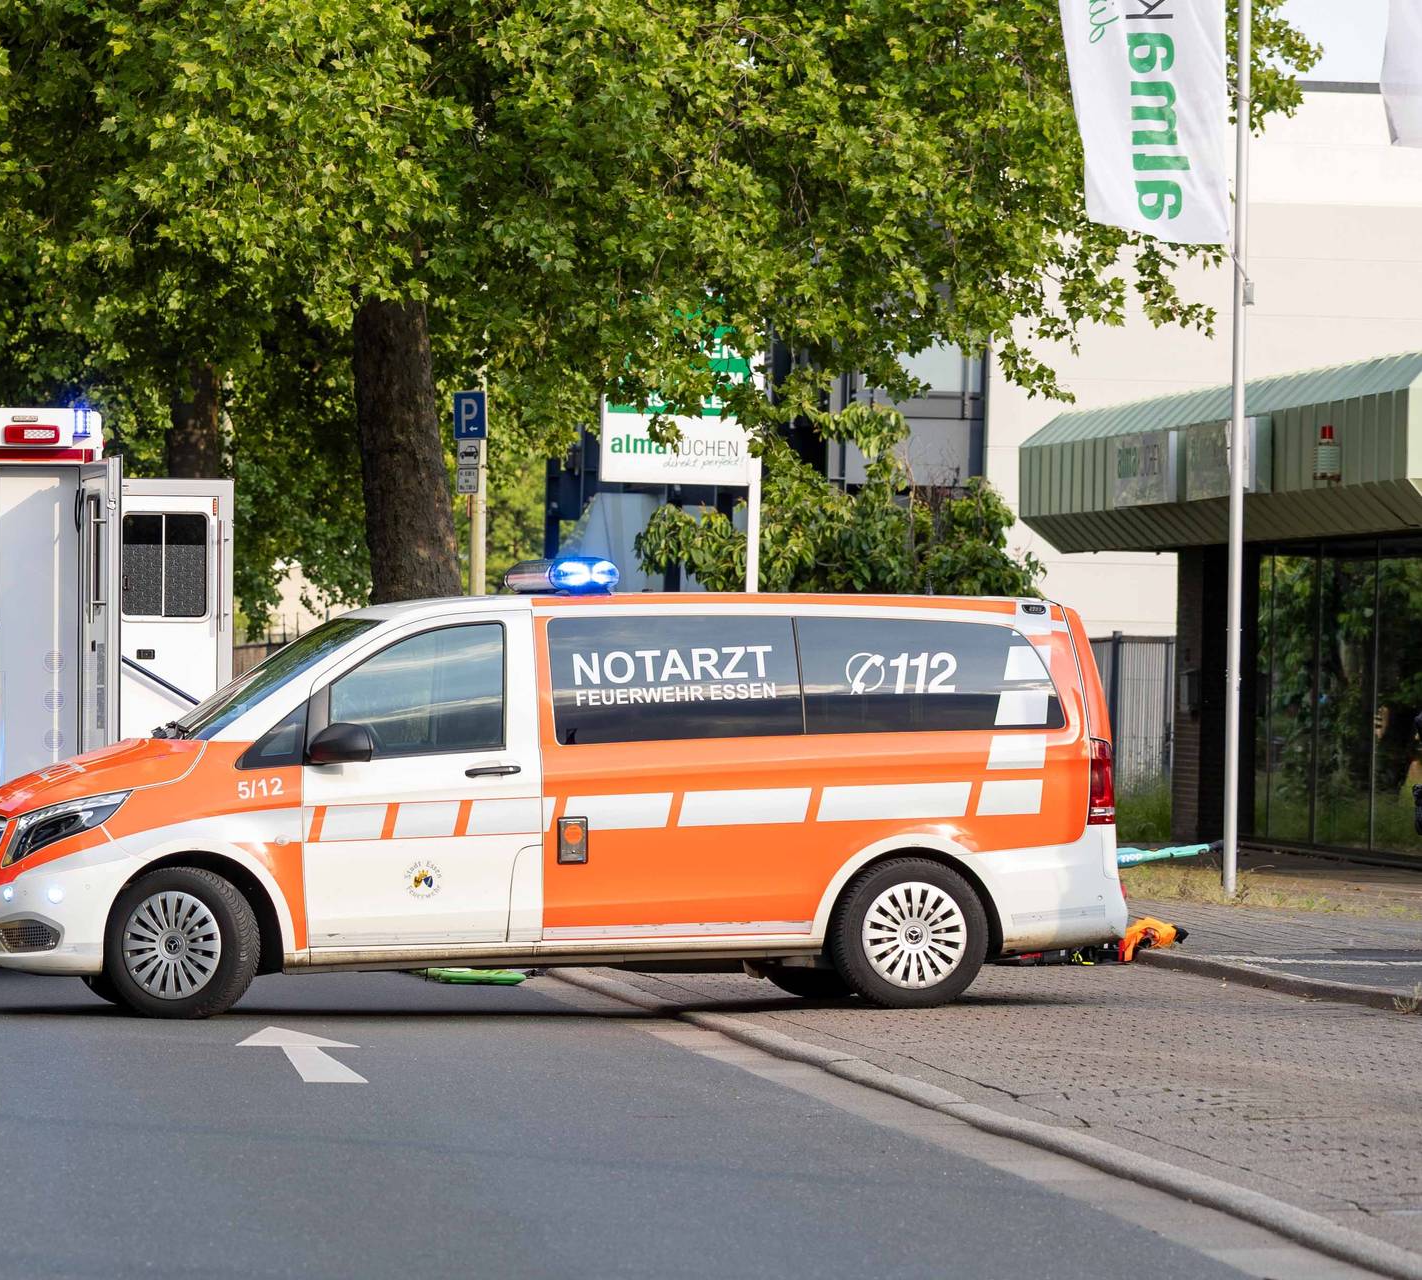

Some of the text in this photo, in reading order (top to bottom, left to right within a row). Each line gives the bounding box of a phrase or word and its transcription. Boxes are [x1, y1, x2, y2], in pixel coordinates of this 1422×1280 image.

[460, 398, 478, 433] P
[572, 645, 773, 686] NOTARZT
[889, 652, 958, 695] 112
[576, 682, 777, 707] FEUERWEHR ESSEN
[237, 777, 285, 800] 5/12
